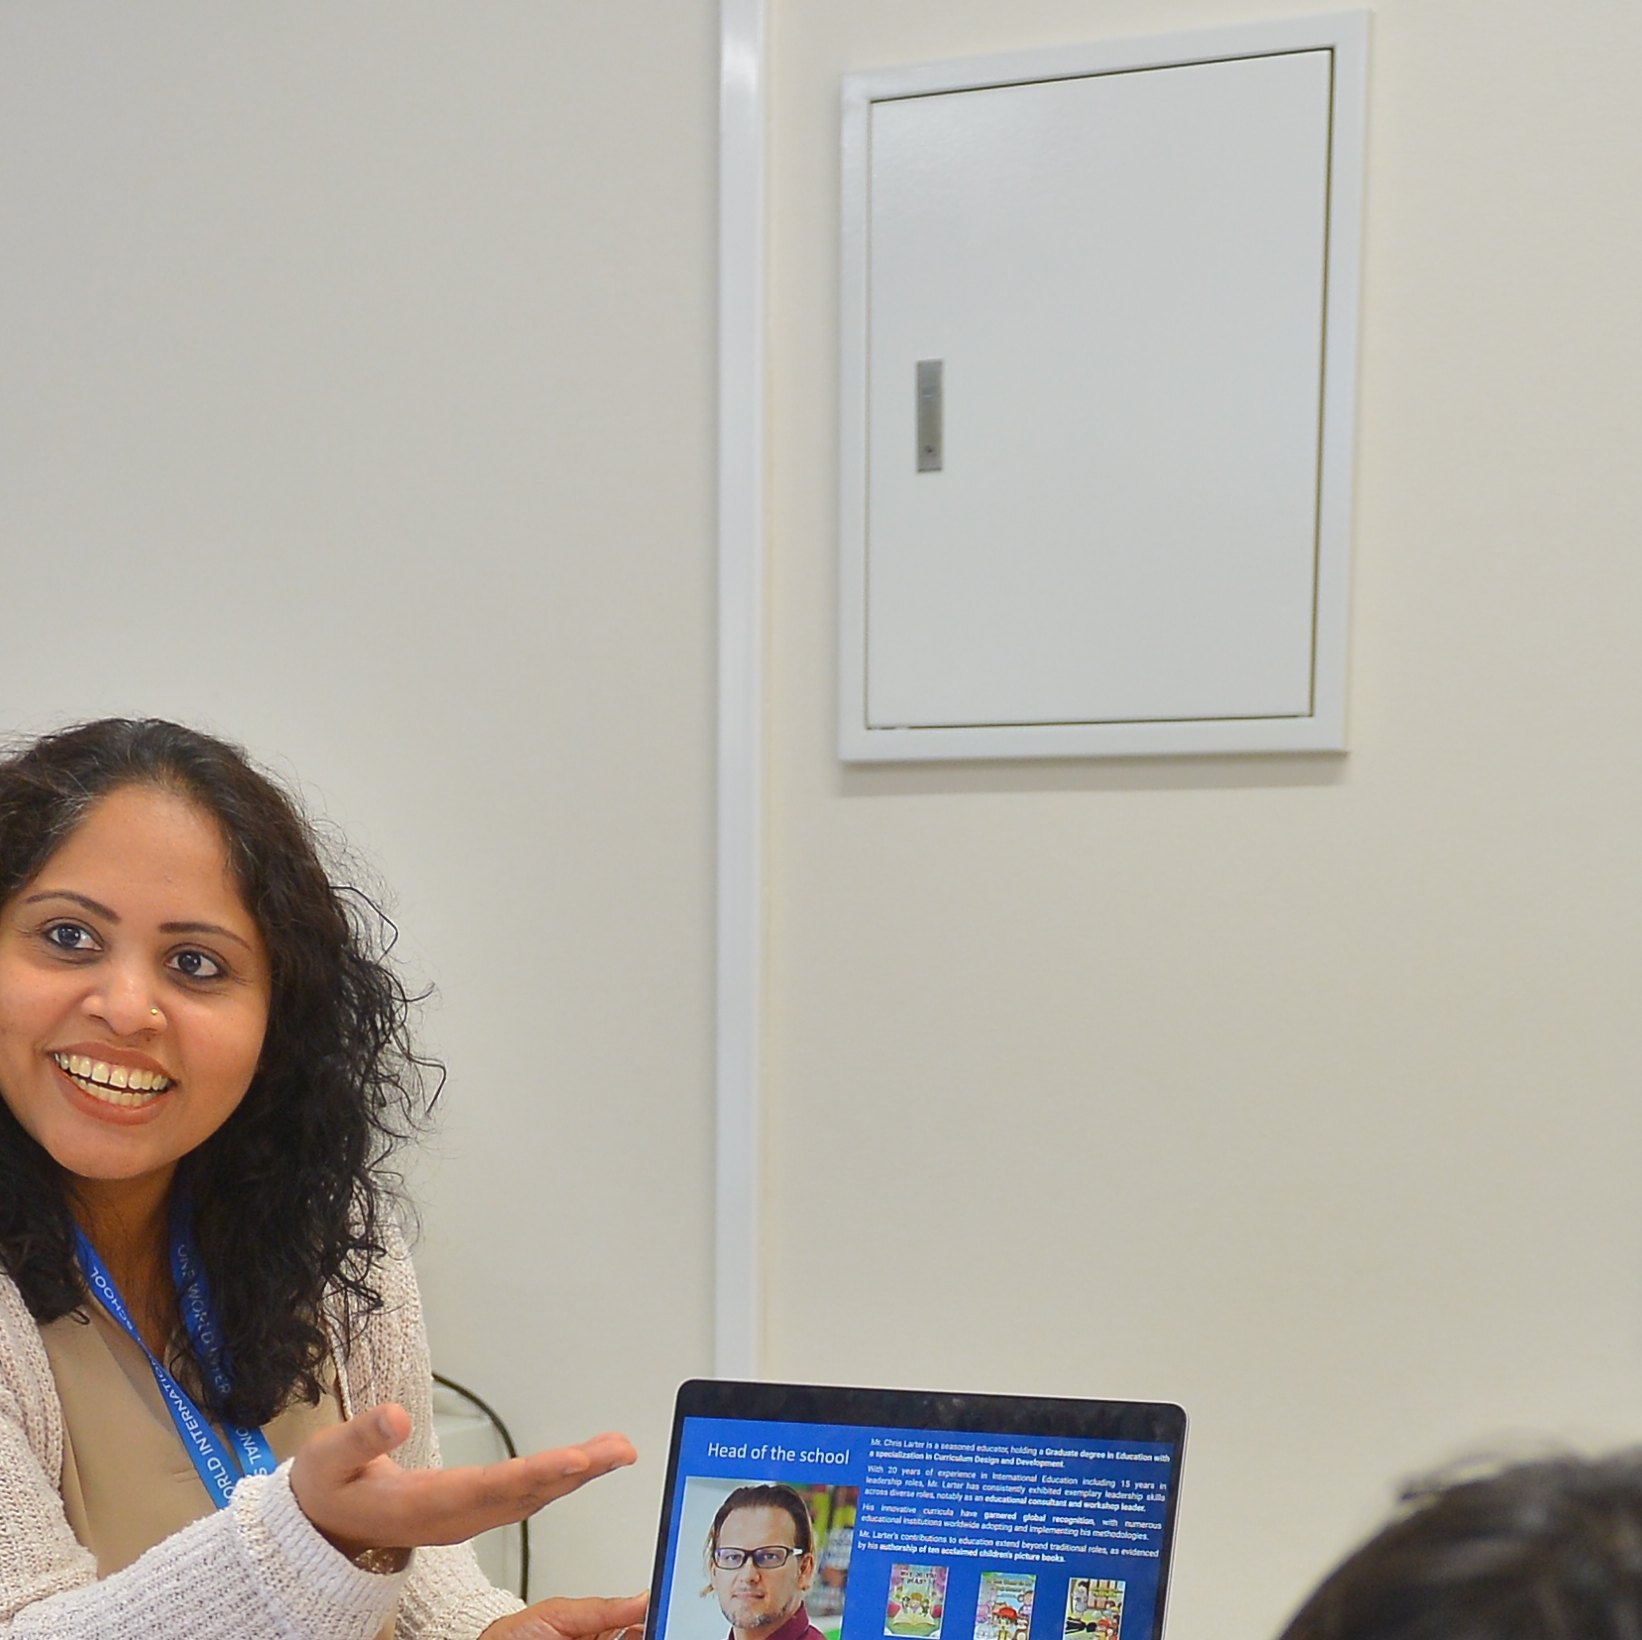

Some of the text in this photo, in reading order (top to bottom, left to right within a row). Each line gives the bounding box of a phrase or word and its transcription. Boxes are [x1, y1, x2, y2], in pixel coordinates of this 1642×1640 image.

[91, 1266, 133, 1331] SCHOOL
[188, 1283, 215, 1345] WORLD
[708, 1442, 850, 1464] Head of the school
[876, 1450, 924, 1460] specialization
[934, 1453, 973, 1462] Curriculum
[975, 1456, 999, 1465] Design
[884, 1439, 902, 1447] Chris
[903, 1441, 924, 1449] Larter
[941, 1442, 975, 1451] seasoned
[1011, 1446, 1037, 1455] holding
[1045, 1448, 1078, 1457] Graduate
[1080, 1450, 1105, 1460] degree
[1116, 1453, 1152, 1461] Education
[207, 1456, 235, 1500] ORLD
[866, 1476, 902, 1487] leadership
[942, 1481, 963, 1489] Larter
[982, 1483, 1025, 1494] consistently
[1029, 1486, 1062, 1495] exhibited
[1064, 1489, 1102, 1498] exemplary
[1105, 1490, 1143, 1501] leadership
[902, 1468, 921, 1476] years
[938, 1470, 976, 1479] experience
[992, 1472, 1037, 1482] International
[1042, 1475, 1078, 1485] Education
[1083, 1478, 1115, 1488] including
[1134, 1481, 1154, 1490] years
[889, 1489, 914, 1498] diverse
[937, 1492, 962, 1502] notably
[985, 1495, 1027, 1505] educational
[1028, 1498, 1067, 1507] consultant
[1084, 1501, 1119, 1512] workshop
[861, 1515, 901, 1524] educational
[903, 1517, 942, 1527] institutions
[944, 1520, 979, 1529] worldwide
[981, 1523, 1013, 1533] adopting
[1029, 1525, 1078, 1537] implementing
[881, 1505, 916, 1514] innovative
[923, 1507, 954, 1516] curricula
[984, 1512, 1017, 1521] garnered
[1023, 1513, 1046, 1522] global
[1125, 1521, 1162, 1529] numerous
[880, 1543, 917, 1554] authorship
[941, 1547, 978, 1557] acclaimed
[1014, 1552, 1040, 1561] picture
[901, 1533, 947, 1543] contributions
[959, 1537, 993, 1546] education
[996, 1539, 1020, 1548] extend
[1022, 1541, 1048, 1551] beyond
[1050, 1543, 1087, 1552] traditional
[1121, 1548, 1159, 1558] evidenced
